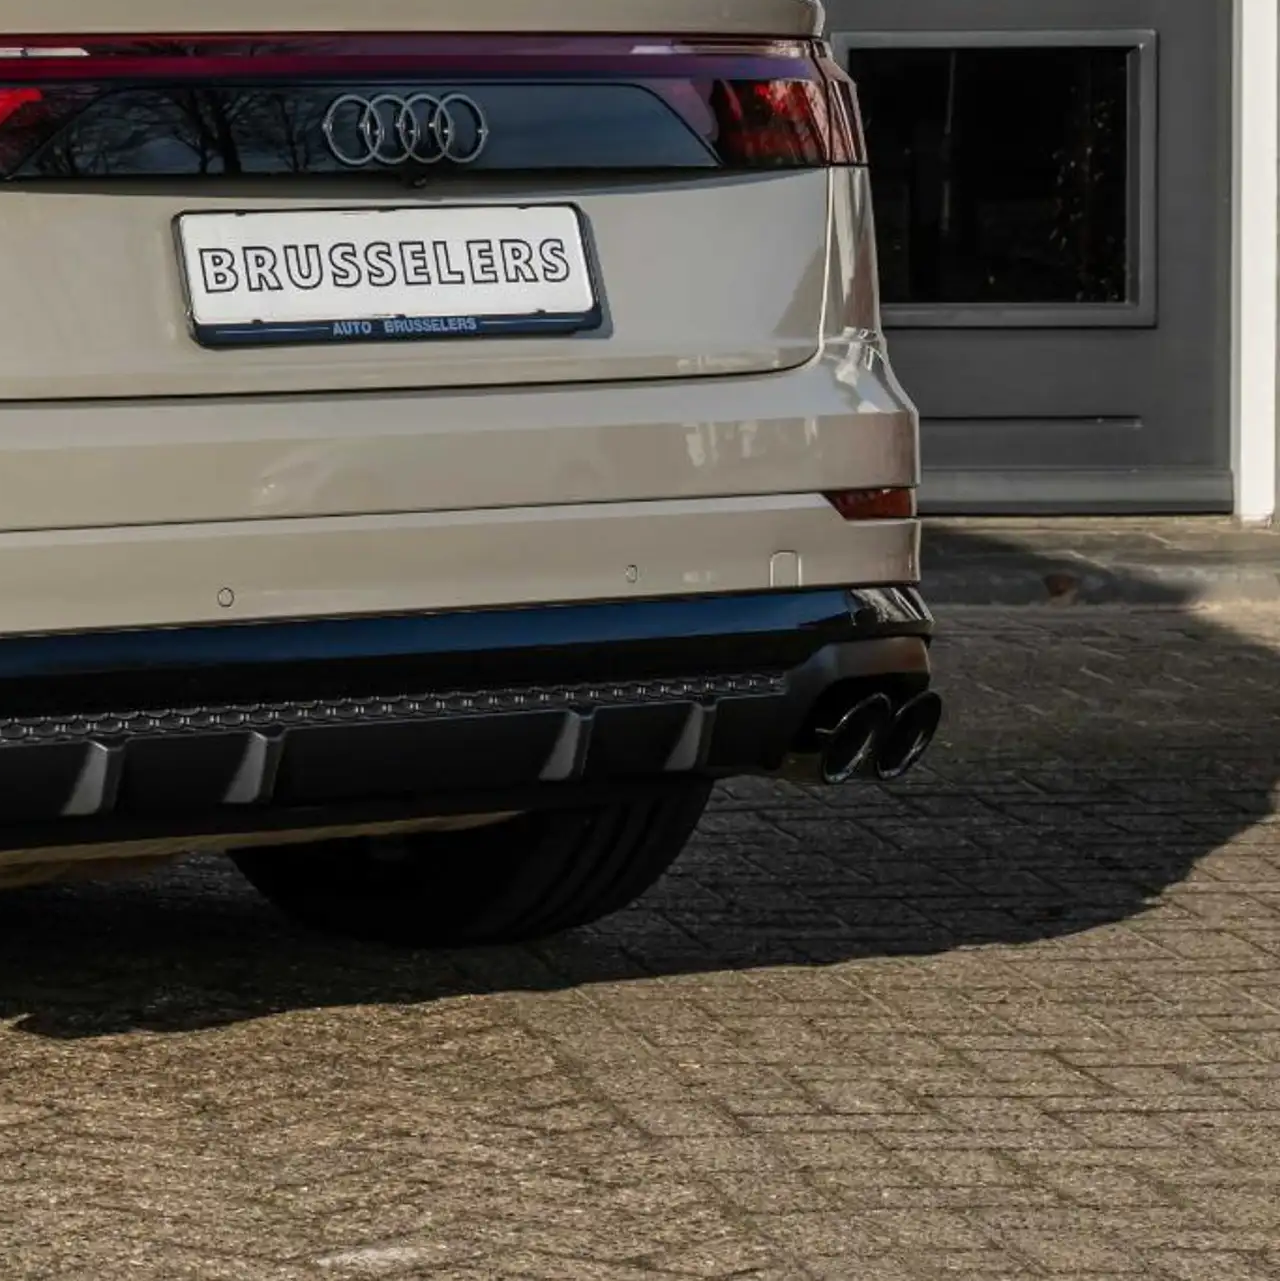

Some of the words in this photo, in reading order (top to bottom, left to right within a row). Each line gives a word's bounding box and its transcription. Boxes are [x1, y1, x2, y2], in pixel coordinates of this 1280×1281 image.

[198, 239, 570, 293] BRUSSELERS
[333, 320, 372, 335] AUTO
[384, 317, 477, 333] BRUSSELERS
